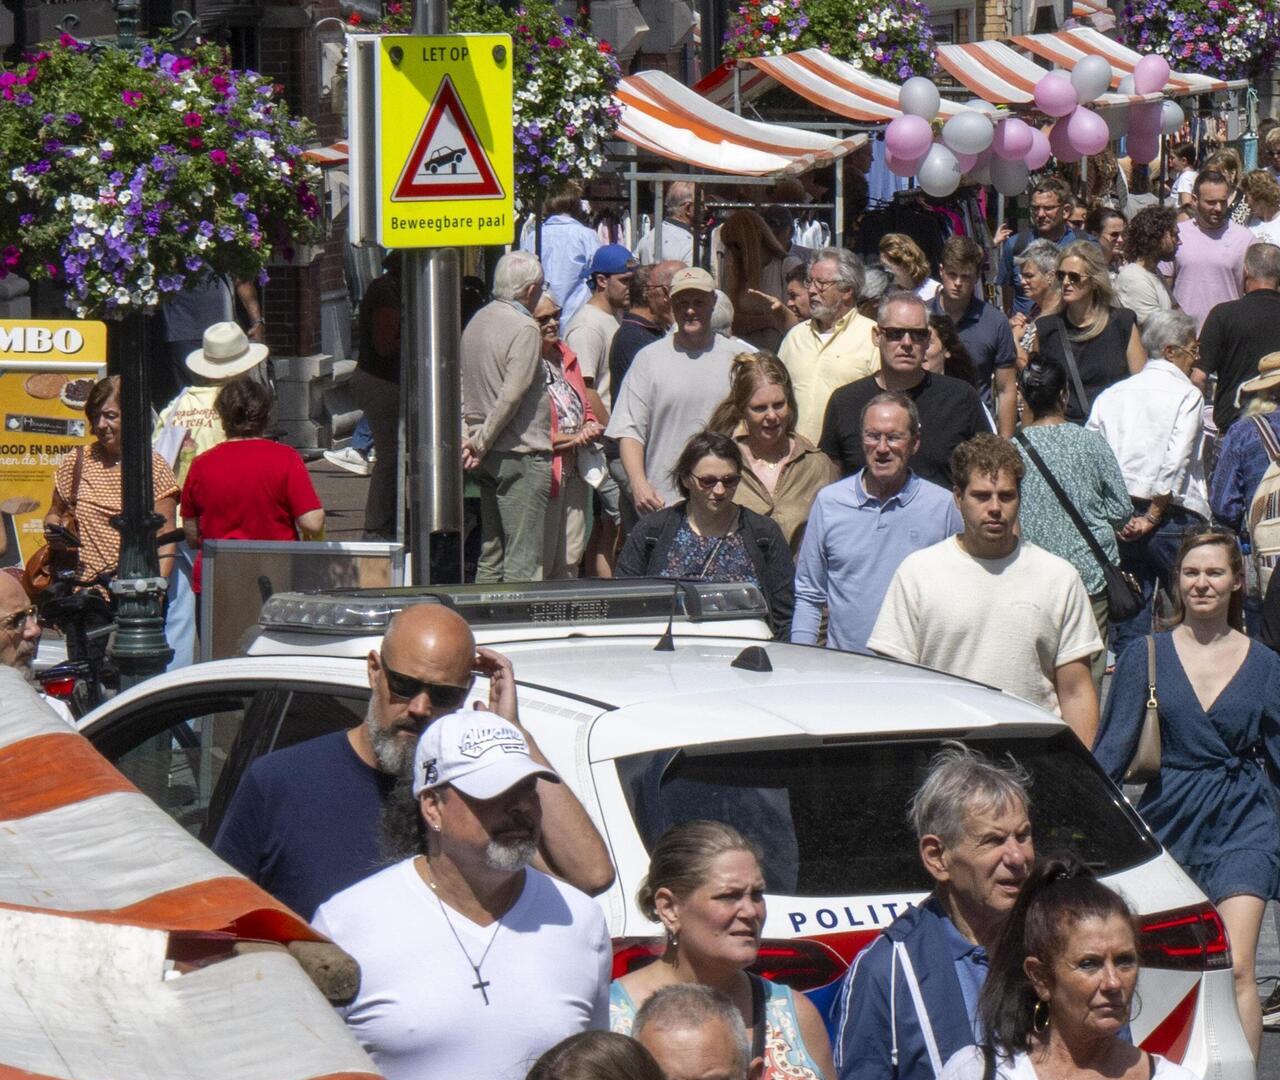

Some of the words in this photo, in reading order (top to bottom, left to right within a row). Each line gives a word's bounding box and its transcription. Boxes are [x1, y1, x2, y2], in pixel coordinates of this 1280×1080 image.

[422, 47, 444, 62] LET
[450, 47, 469, 62] OP
[391, 215, 473, 232] Beweegbare
[478, 213, 505, 230] paal
[0, 444, 26, 455] OOD
[30, 444, 42, 455] EN
[788, 902, 917, 933] POLIT
